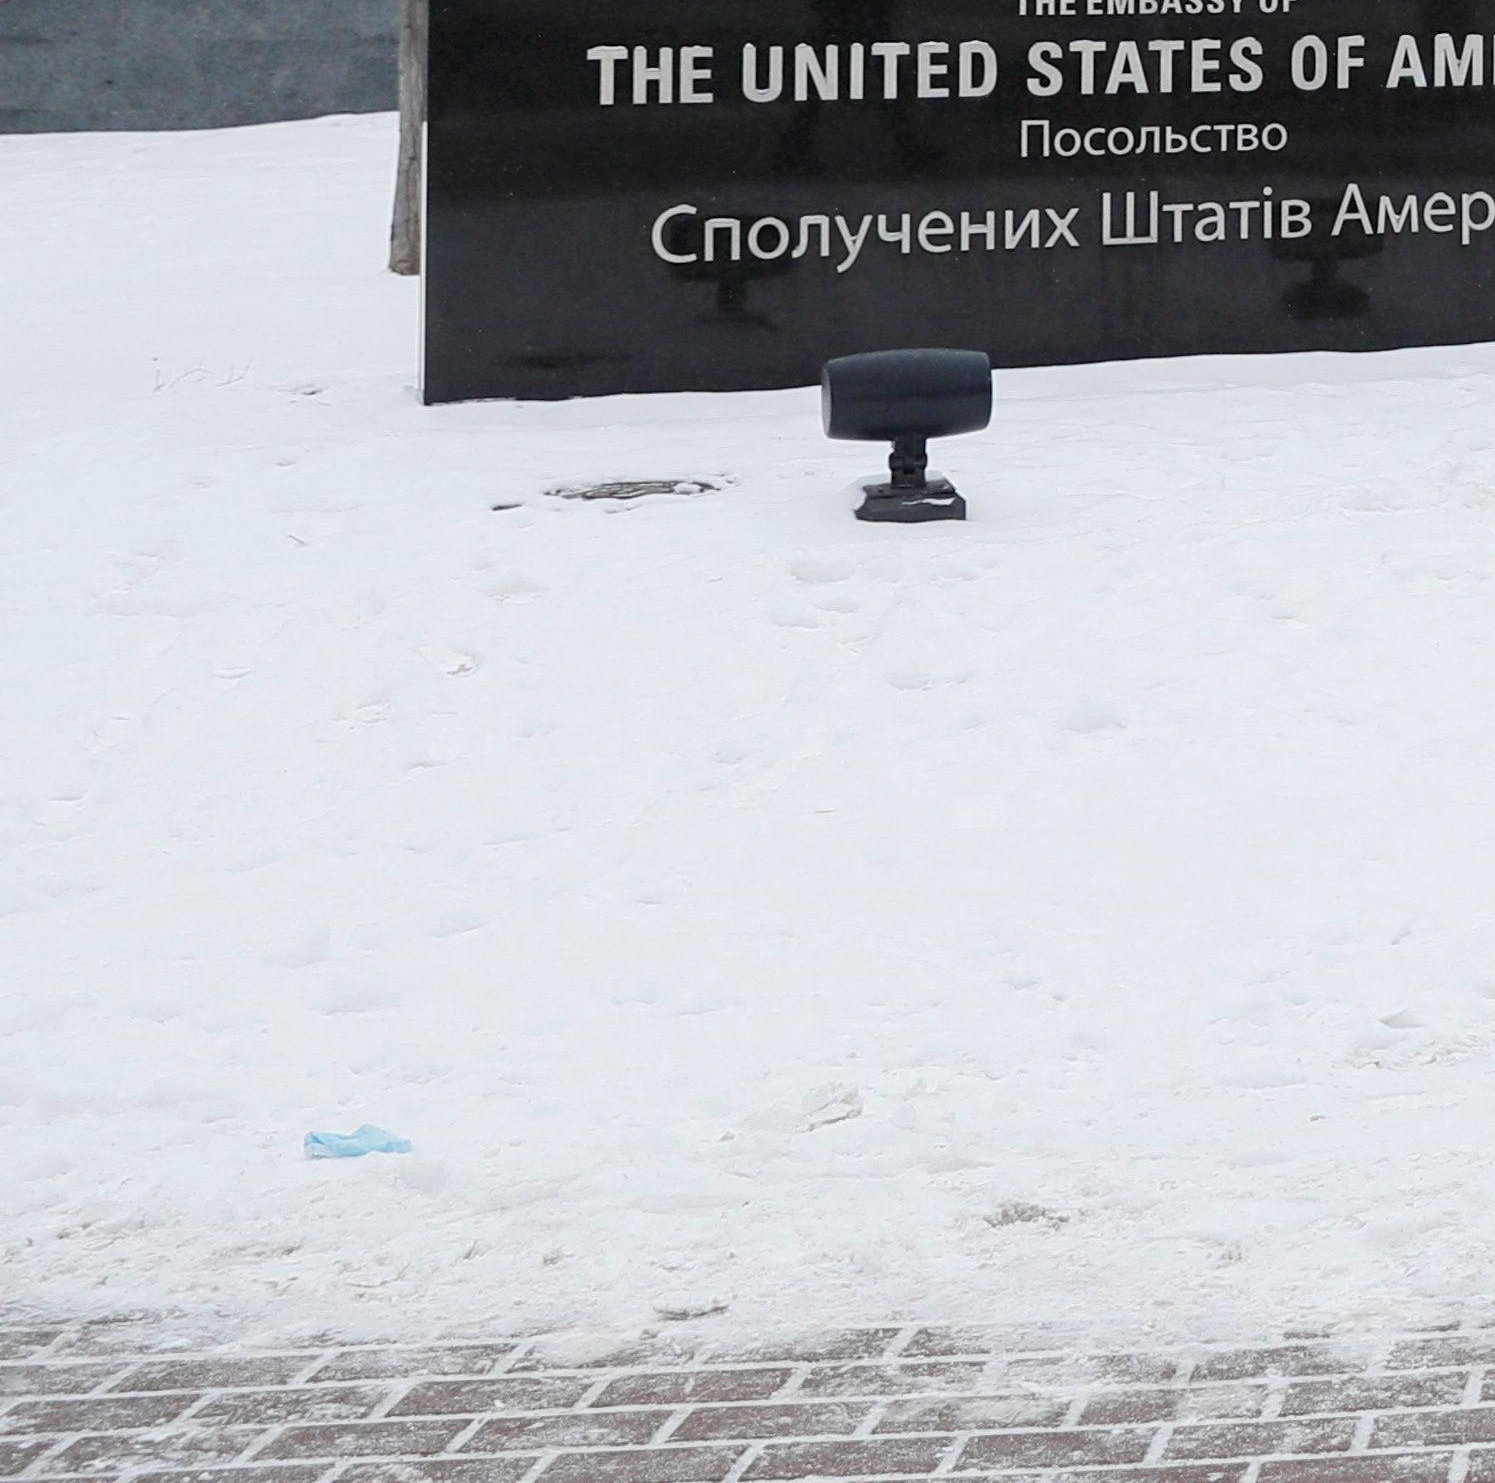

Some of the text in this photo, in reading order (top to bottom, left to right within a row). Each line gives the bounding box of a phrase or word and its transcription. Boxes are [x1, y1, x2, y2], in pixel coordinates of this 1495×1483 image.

[587, 45, 714, 105] THE
[742, 40, 998, 103] UNITED
[1026, 36, 1263, 97] STATES
[1291, 34, 1365, 91] OF
[1021, 119, 1288, 158] Посольство
[651, 204, 1080, 273] Сполучених
[1102, 185, 1312, 246] Штатів
